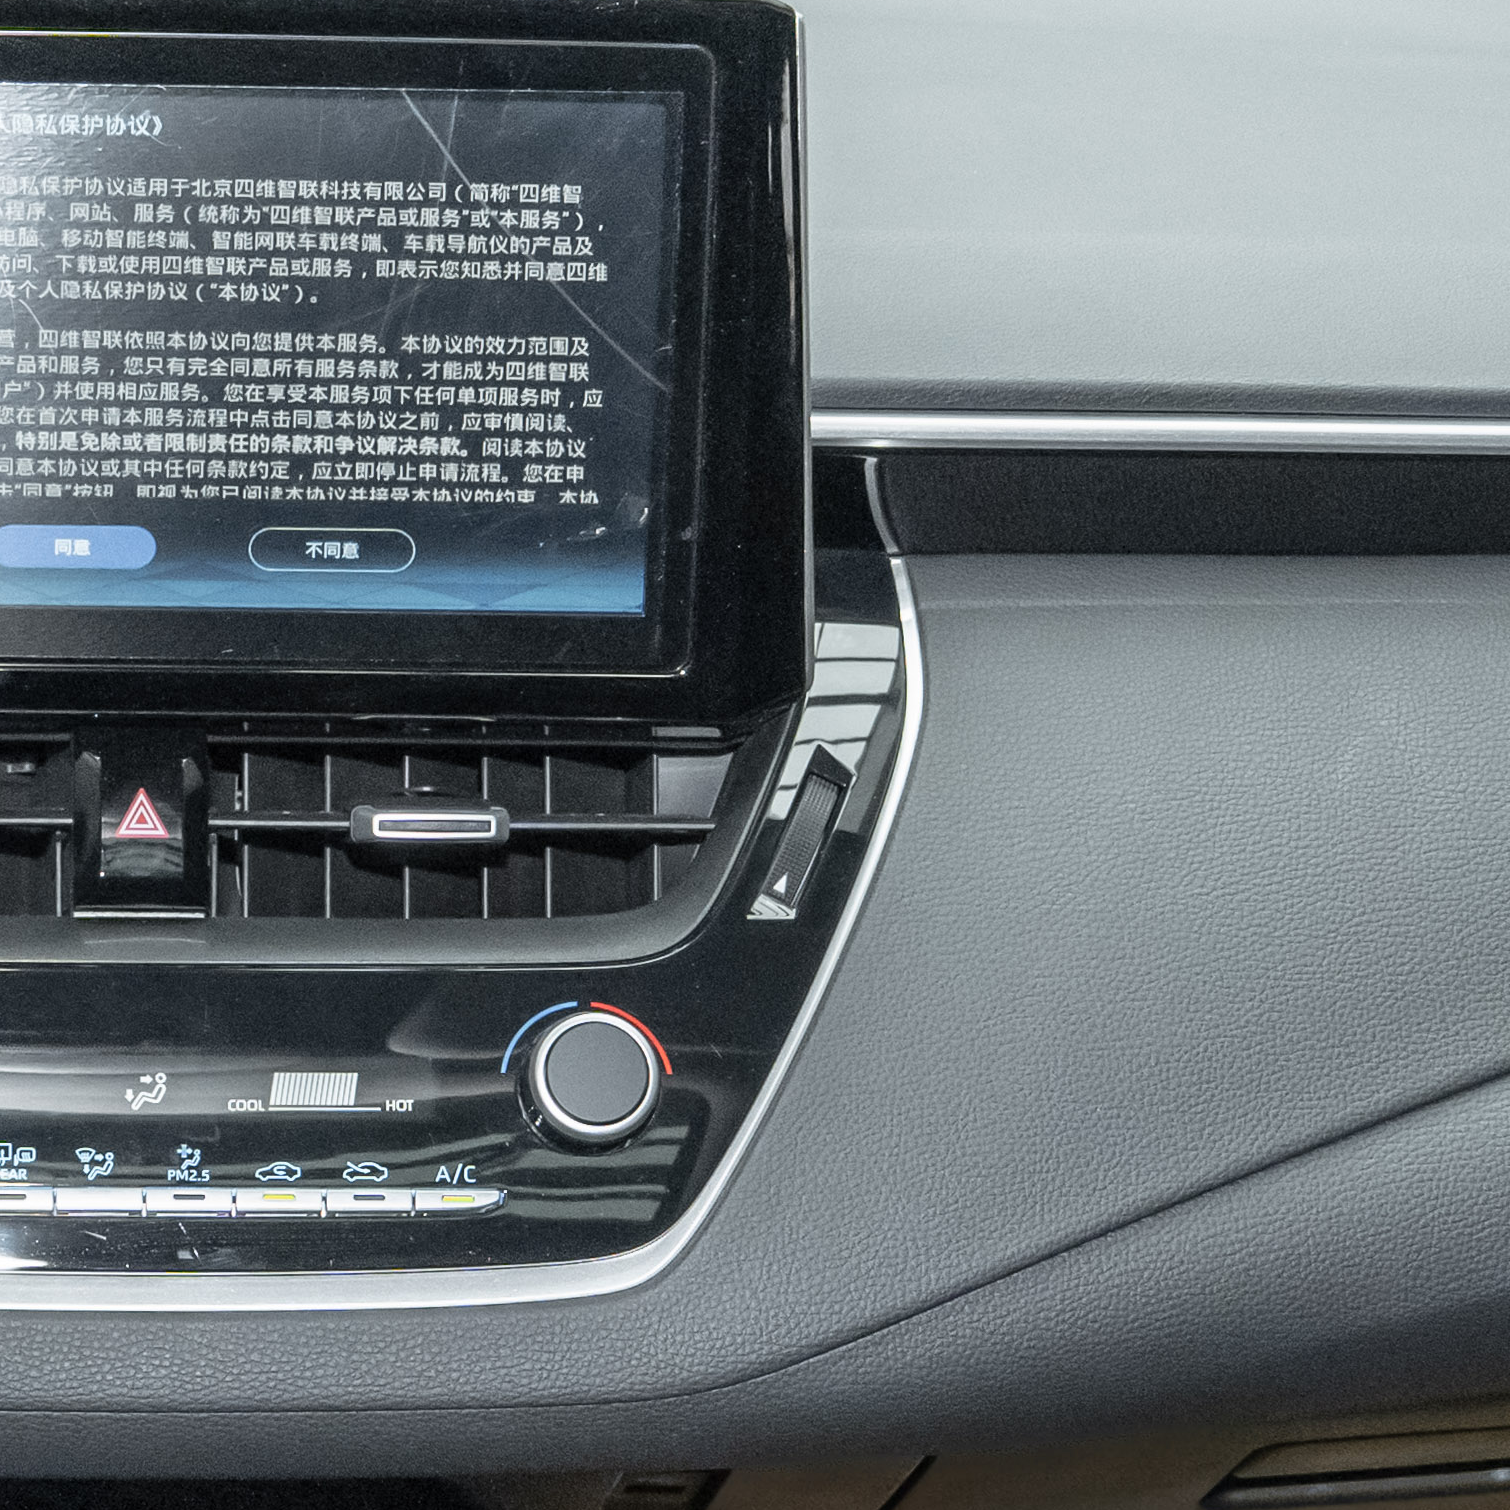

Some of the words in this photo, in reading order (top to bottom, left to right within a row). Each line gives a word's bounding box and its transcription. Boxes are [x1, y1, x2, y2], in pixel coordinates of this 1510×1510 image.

[53, 537, 91, 558] 同意
[305, 541, 361, 562] 不同意
[226, 1098, 266, 1113] COOL
[384, 1098, 415, 1113] HOT
[166, 1168, 211, 1183] PM2.5
[434, 1162, 478, 1184] A/C
